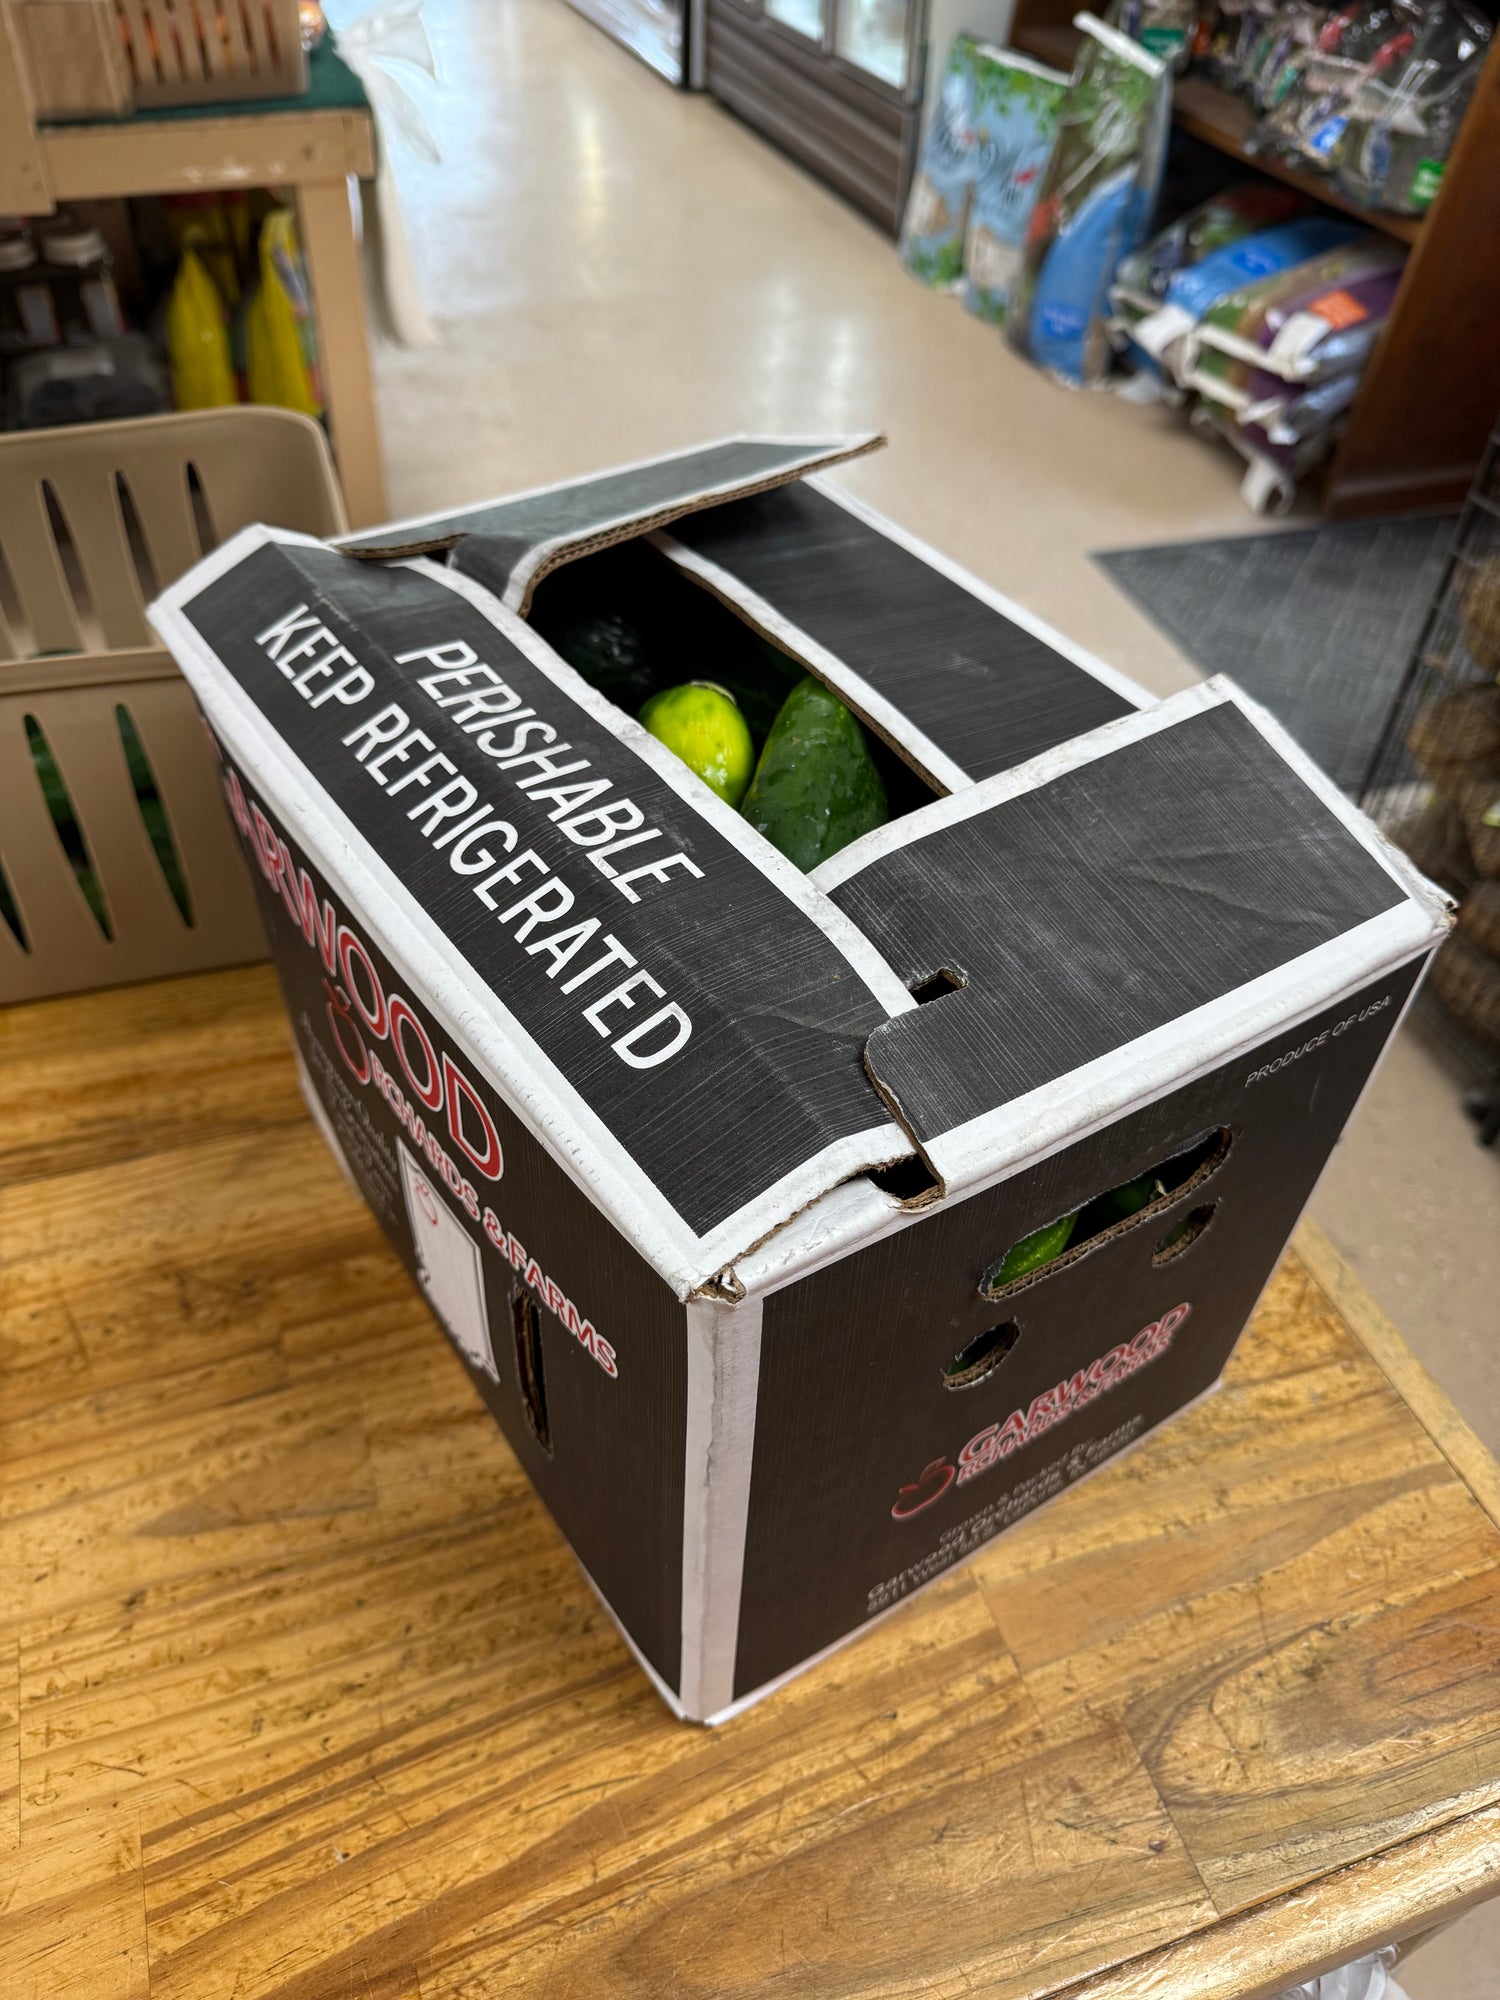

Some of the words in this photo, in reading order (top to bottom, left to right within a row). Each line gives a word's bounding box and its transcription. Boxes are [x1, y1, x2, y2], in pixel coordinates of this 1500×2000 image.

[255, 604, 375, 709] KEEP
[341, 703, 693, 1070] REFRIGERATED
[395, 640, 705, 904] PERISHABLE
[201, 717, 503, 1182] ARWOOD
[1244, 1029, 1330, 1088] PRODUCE
[1332, 1014, 1358, 1037] OF
[1358, 995, 1392, 1023] USA
[483, 1207, 508, 1259] &
[508, 1231, 619, 1378] FARMS
[1073, 1384, 1102, 1411] &
[1101, 1330, 1174, 1391] FARMS
[958, 1302, 1191, 1466] GARWOOD
[868, 1530, 967, 1602] Garwood
